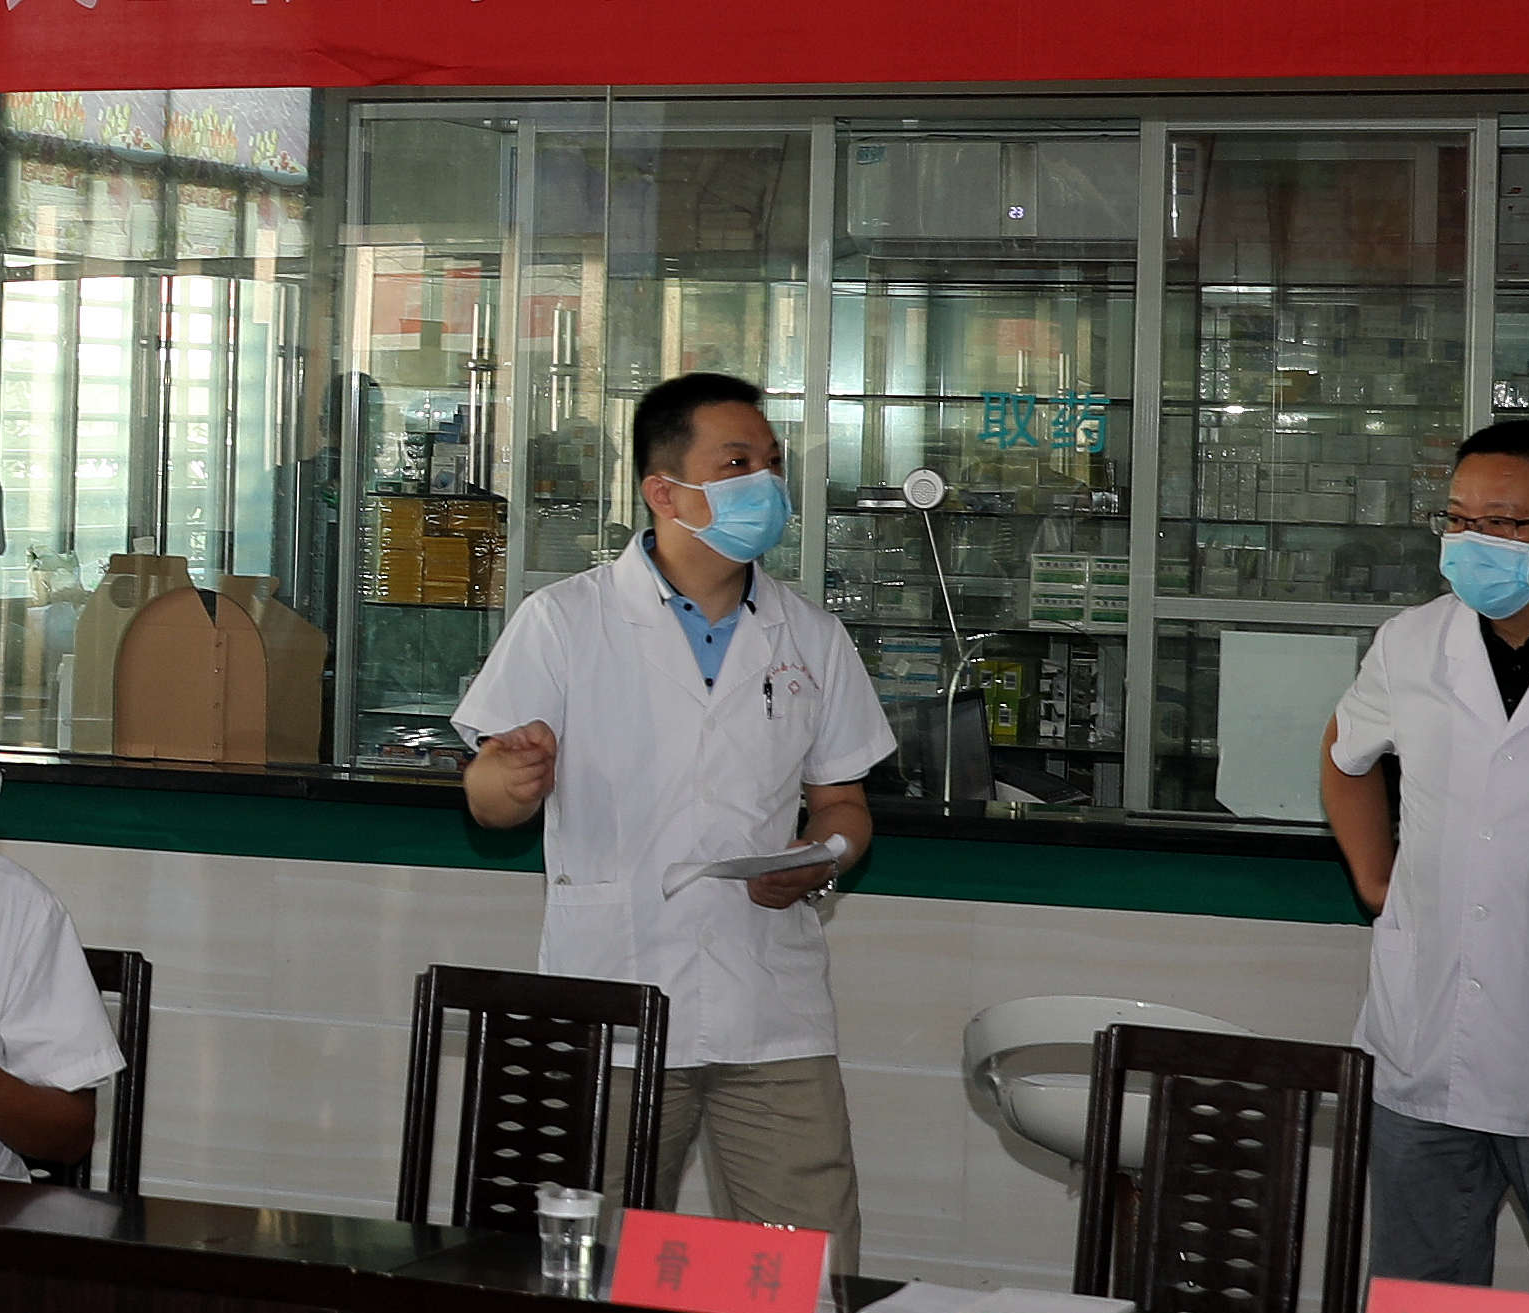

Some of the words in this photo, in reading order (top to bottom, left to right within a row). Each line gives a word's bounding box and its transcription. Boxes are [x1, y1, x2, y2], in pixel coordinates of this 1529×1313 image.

[1008, 206, 1024, 219] 23
[977, 391, 1110, 452] 取药
[655, 1238, 784, 1303] 骨科
